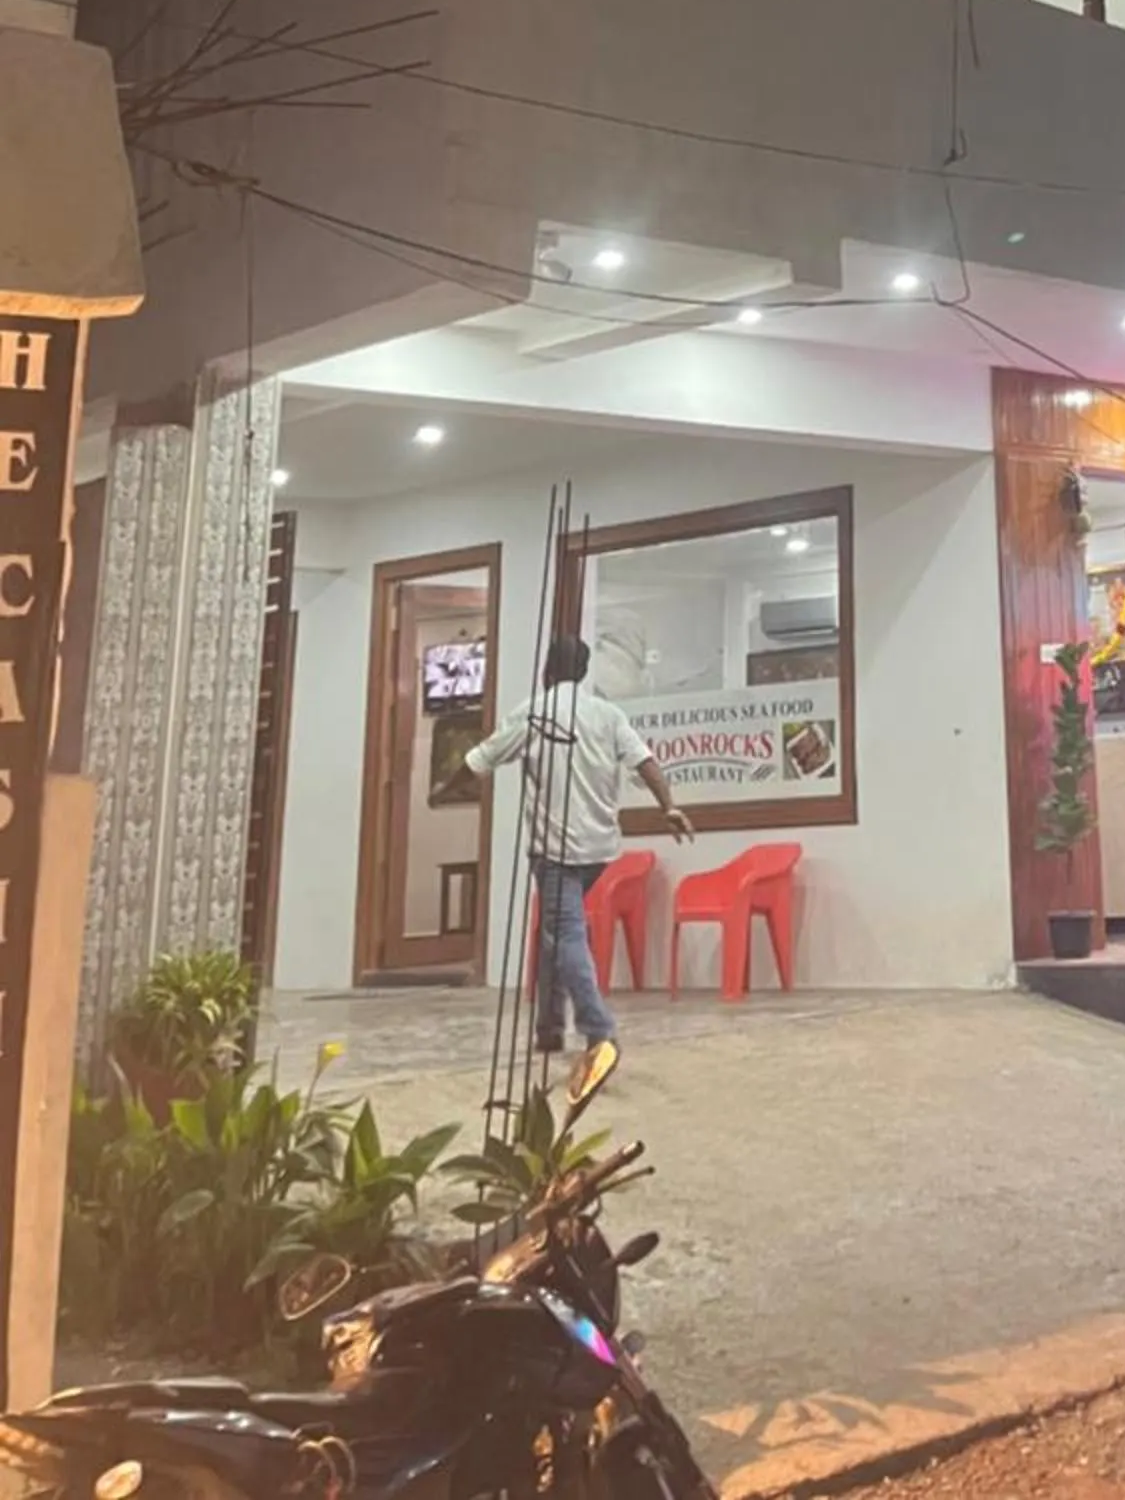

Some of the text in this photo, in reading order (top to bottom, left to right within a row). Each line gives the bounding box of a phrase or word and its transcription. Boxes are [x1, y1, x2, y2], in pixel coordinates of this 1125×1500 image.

[661, 706, 738, 728] DELICIOUS
[770, 699, 813, 717] FOOD
[647, 730, 775, 763] OONROCKS
[665, 767, 743, 784] ESTAURANT
